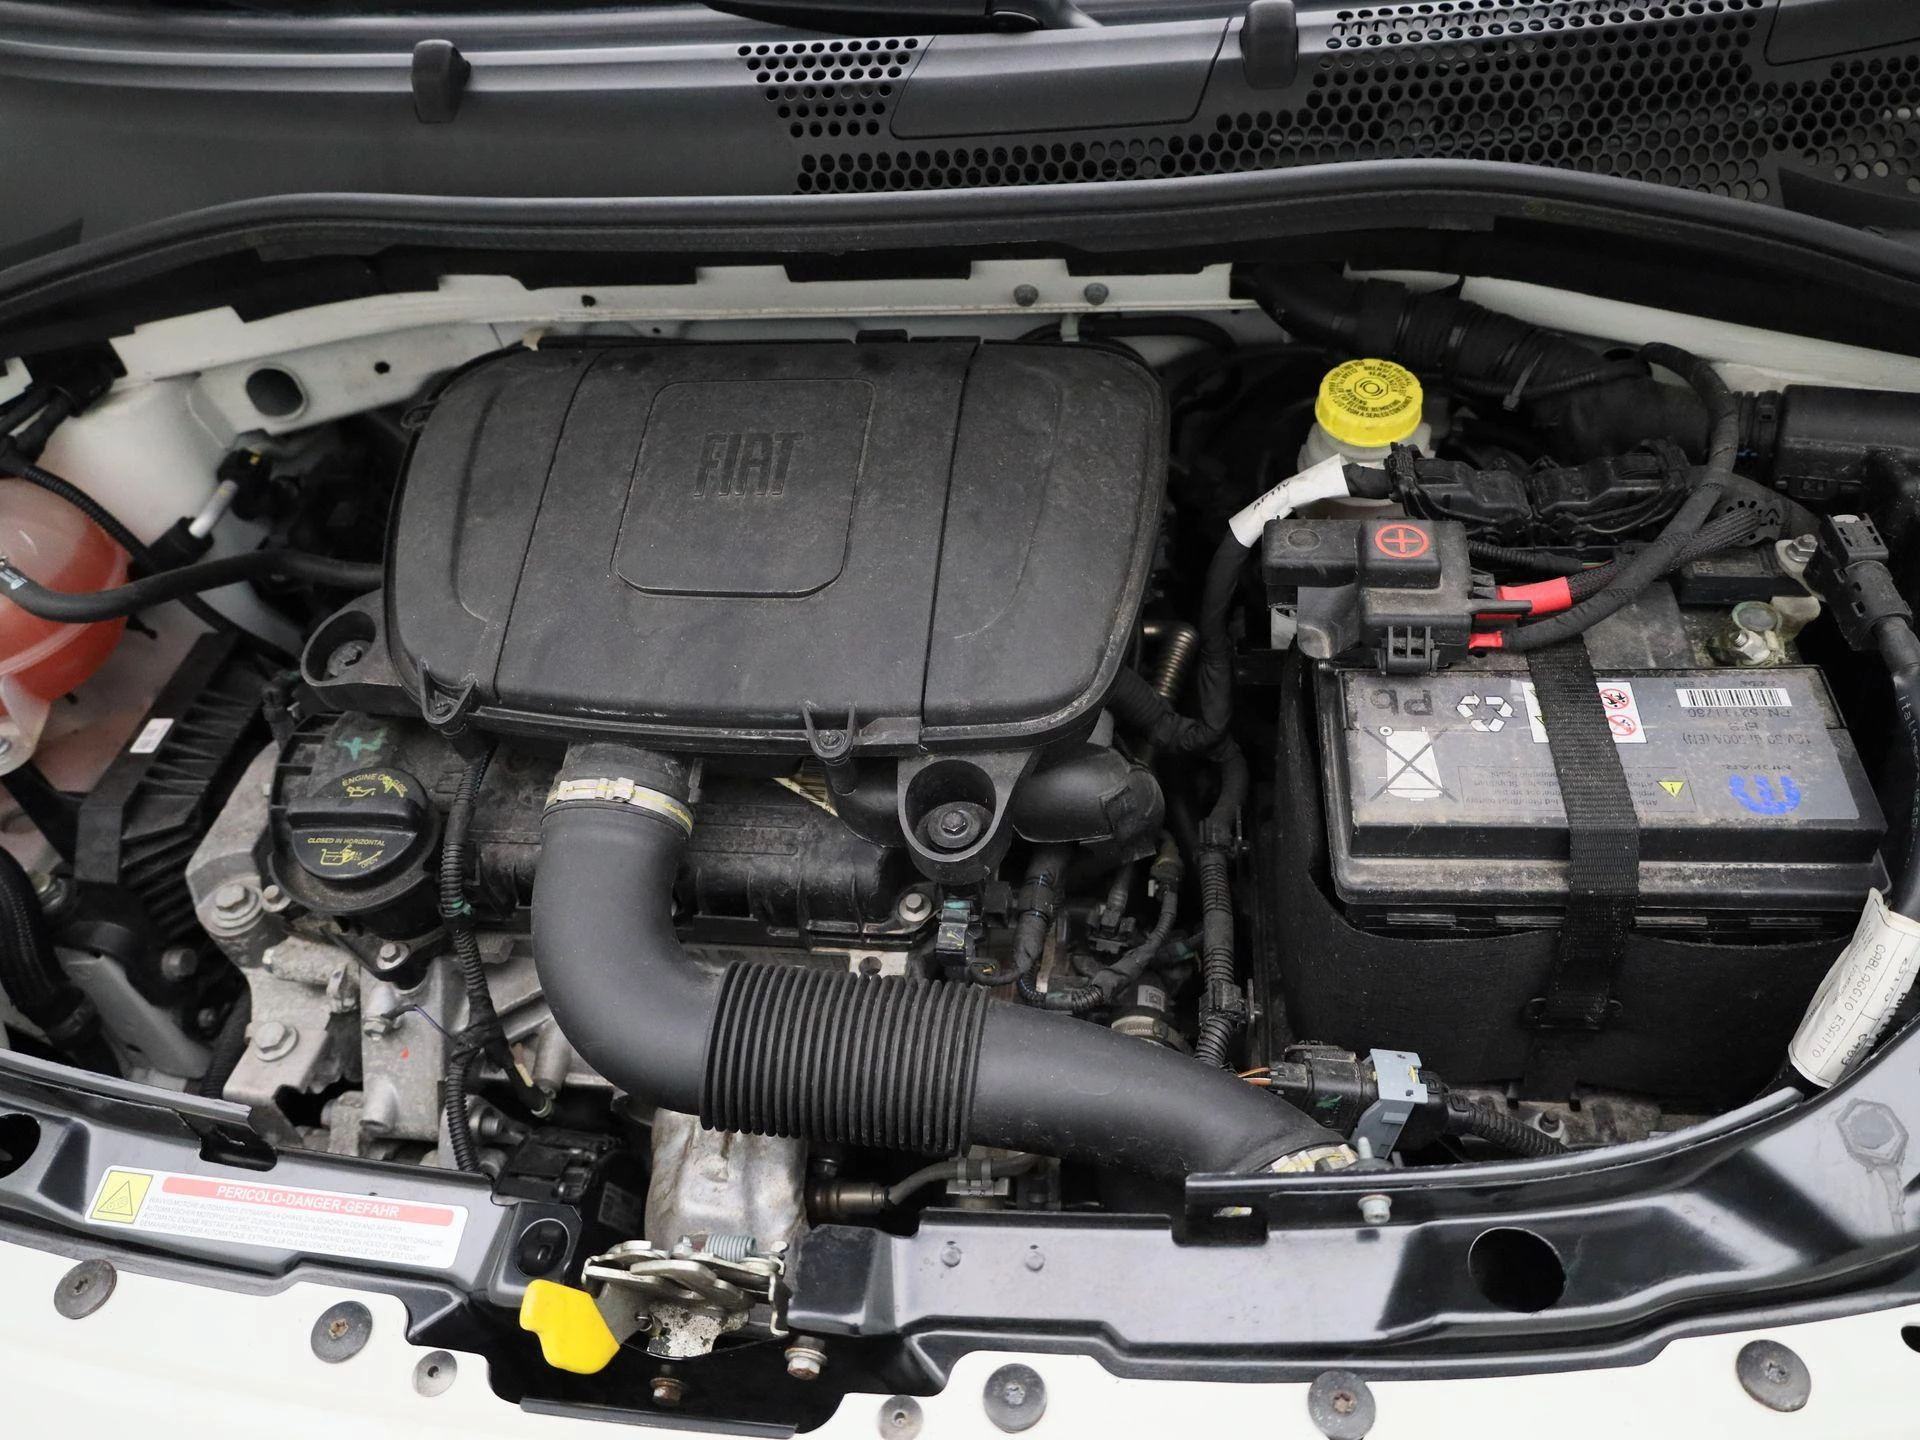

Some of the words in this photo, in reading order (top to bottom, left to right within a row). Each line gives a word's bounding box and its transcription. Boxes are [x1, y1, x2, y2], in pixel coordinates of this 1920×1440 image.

[693, 432, 803, 497] FIAT
[342, 773, 377, 787] ENGINE
[343, 838, 386, 847] HORIZONTAL
[1844, 943, 1887, 1012] CABLAGGIO
[1811, 1014, 1847, 1058] ESATTO
[216, 1184, 400, 1218] PERICOLO-DANGER-GEFAHR
